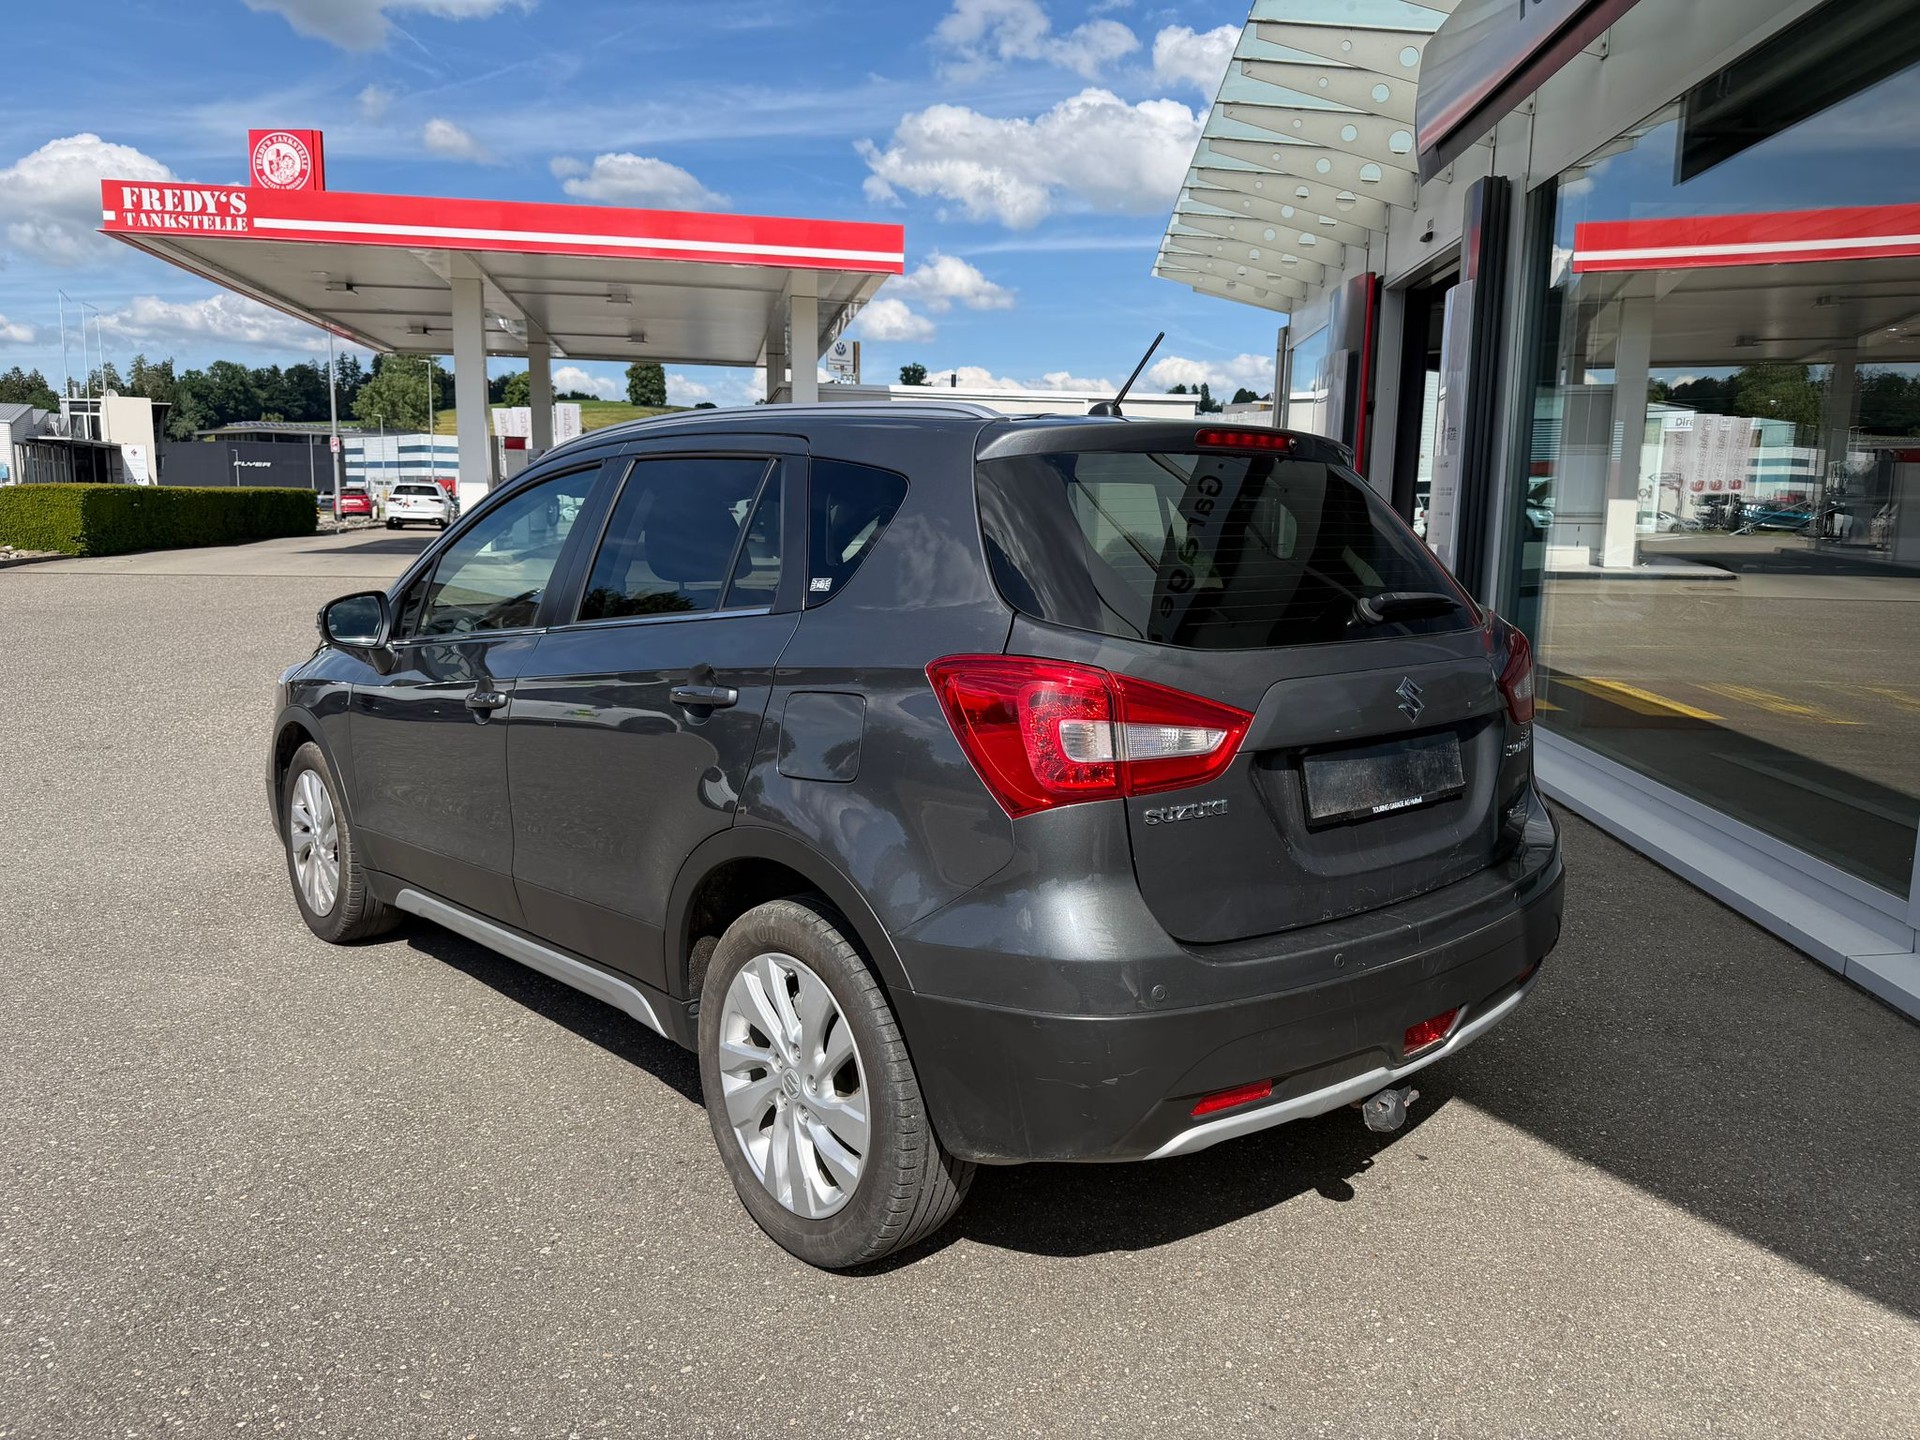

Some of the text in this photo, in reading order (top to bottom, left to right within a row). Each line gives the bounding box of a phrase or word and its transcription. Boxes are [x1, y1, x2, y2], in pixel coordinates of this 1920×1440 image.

[121, 186, 248, 216] FREDY'S
[123, 212, 248, 232] TANKSTELLE
[233, 460, 271, 468] FLYER
[1143, 799, 1229, 825] SUZUKI
